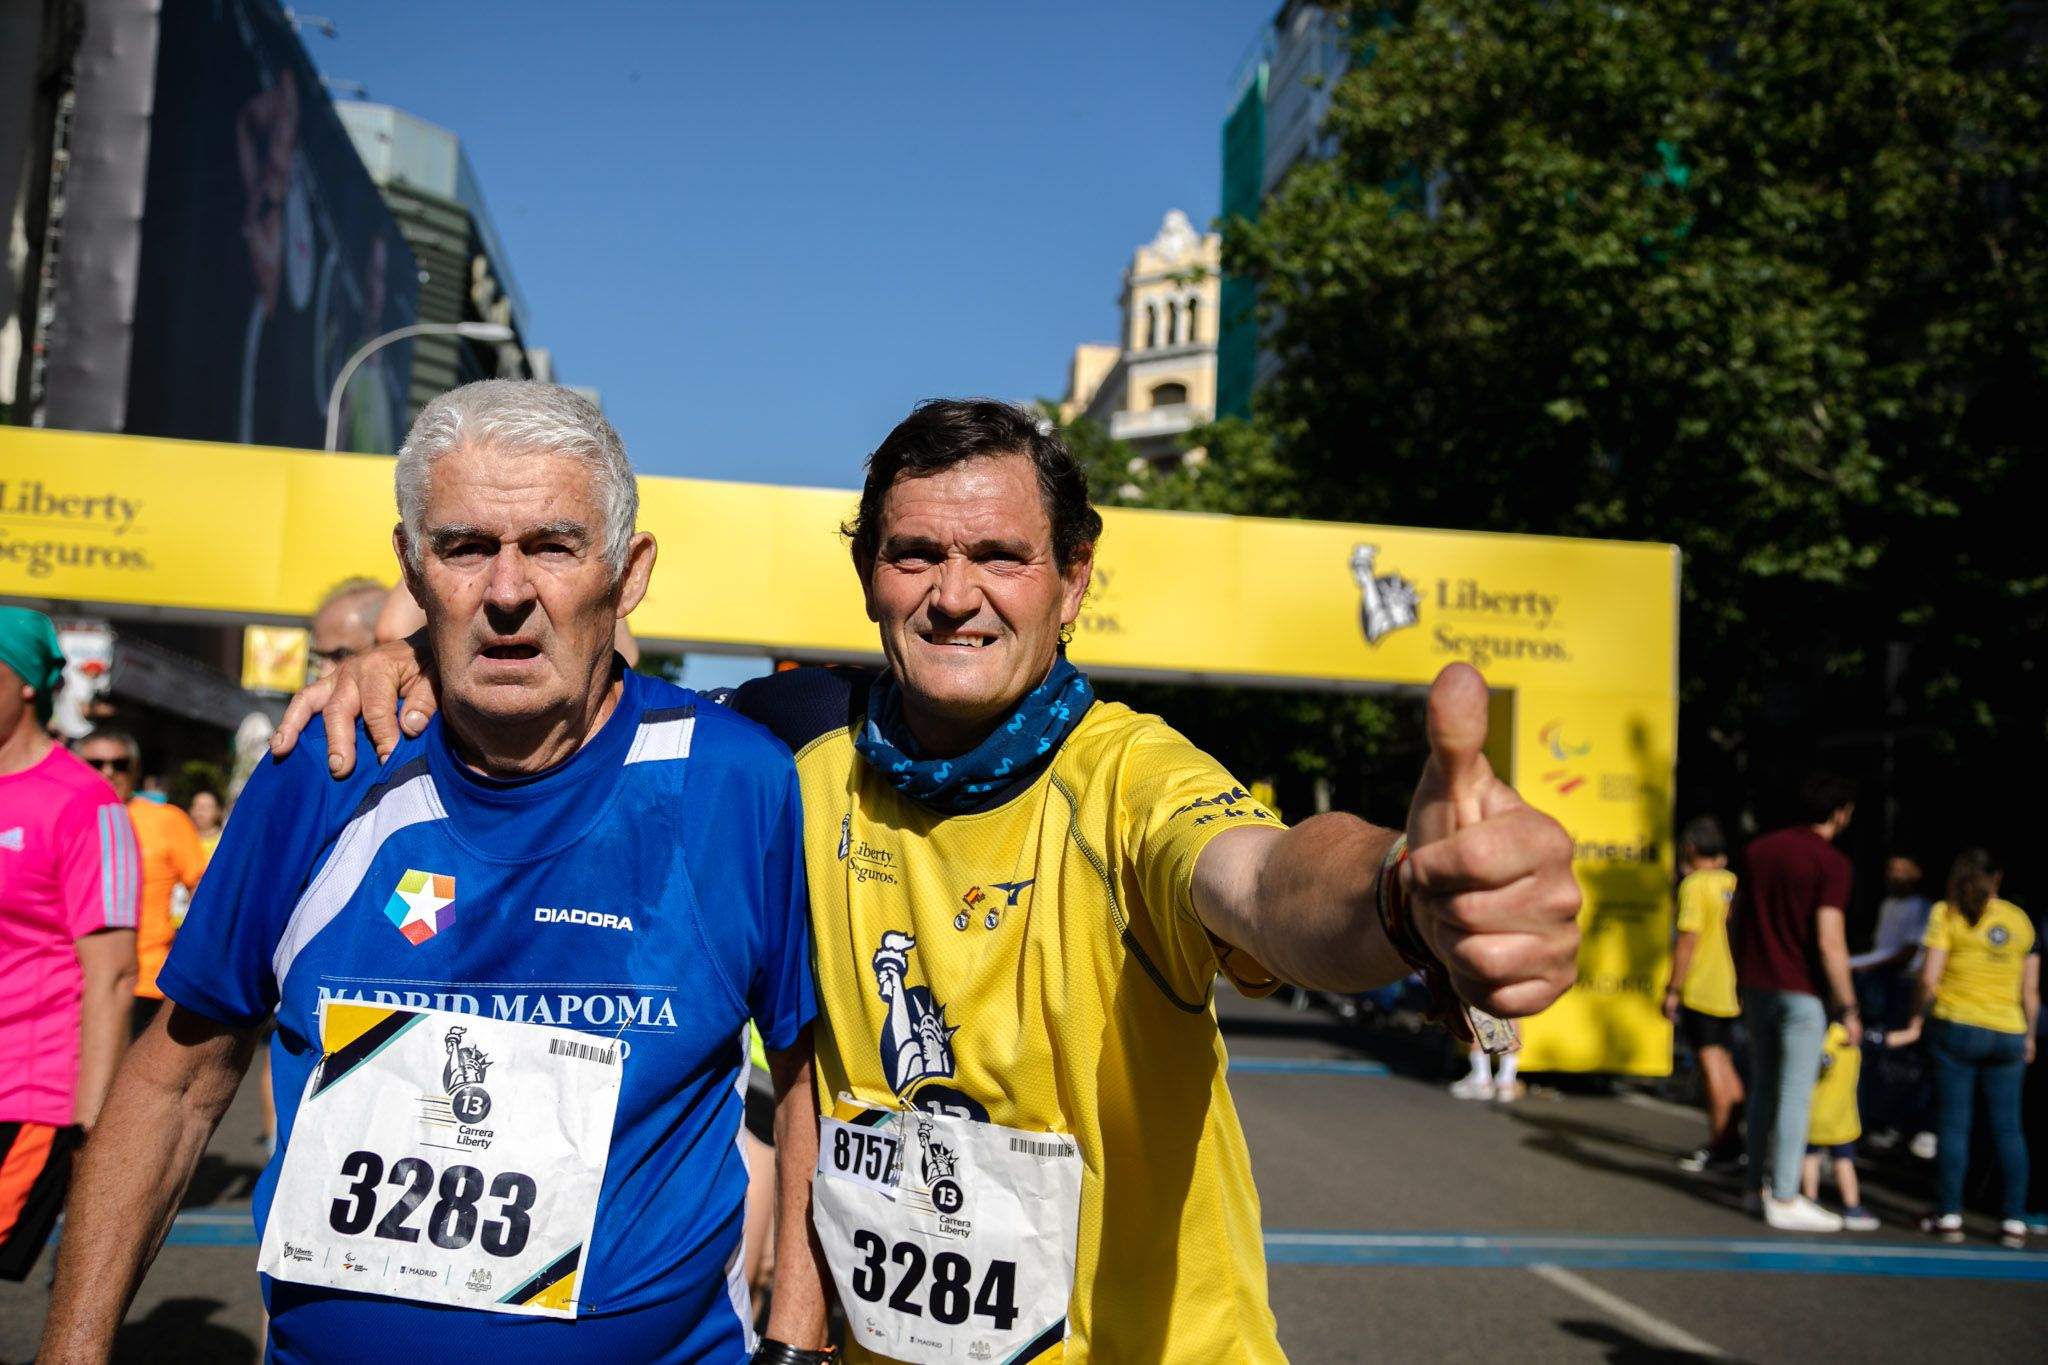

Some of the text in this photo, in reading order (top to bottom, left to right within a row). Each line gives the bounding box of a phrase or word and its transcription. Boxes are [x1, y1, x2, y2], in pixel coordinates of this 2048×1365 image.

[1436, 578, 1559, 631] Liberty
[534, 907, 634, 932] DIADORA
[491, 994, 679, 1027] MAPOMA
[461, 1095, 484, 1116] 13
[459, 1124, 495, 1138] Carrera
[456, 1134, 492, 1150] Liberty
[834, 1127, 898, 1185] 8757
[329, 1150, 537, 1258] 3283
[938, 1186, 958, 1207] 13
[938, 1223, 971, 1239] Liberty
[939, 1214, 972, 1228] Carrera
[408, 1267, 438, 1278] MADRID
[852, 1229, 1019, 1331] 3284
